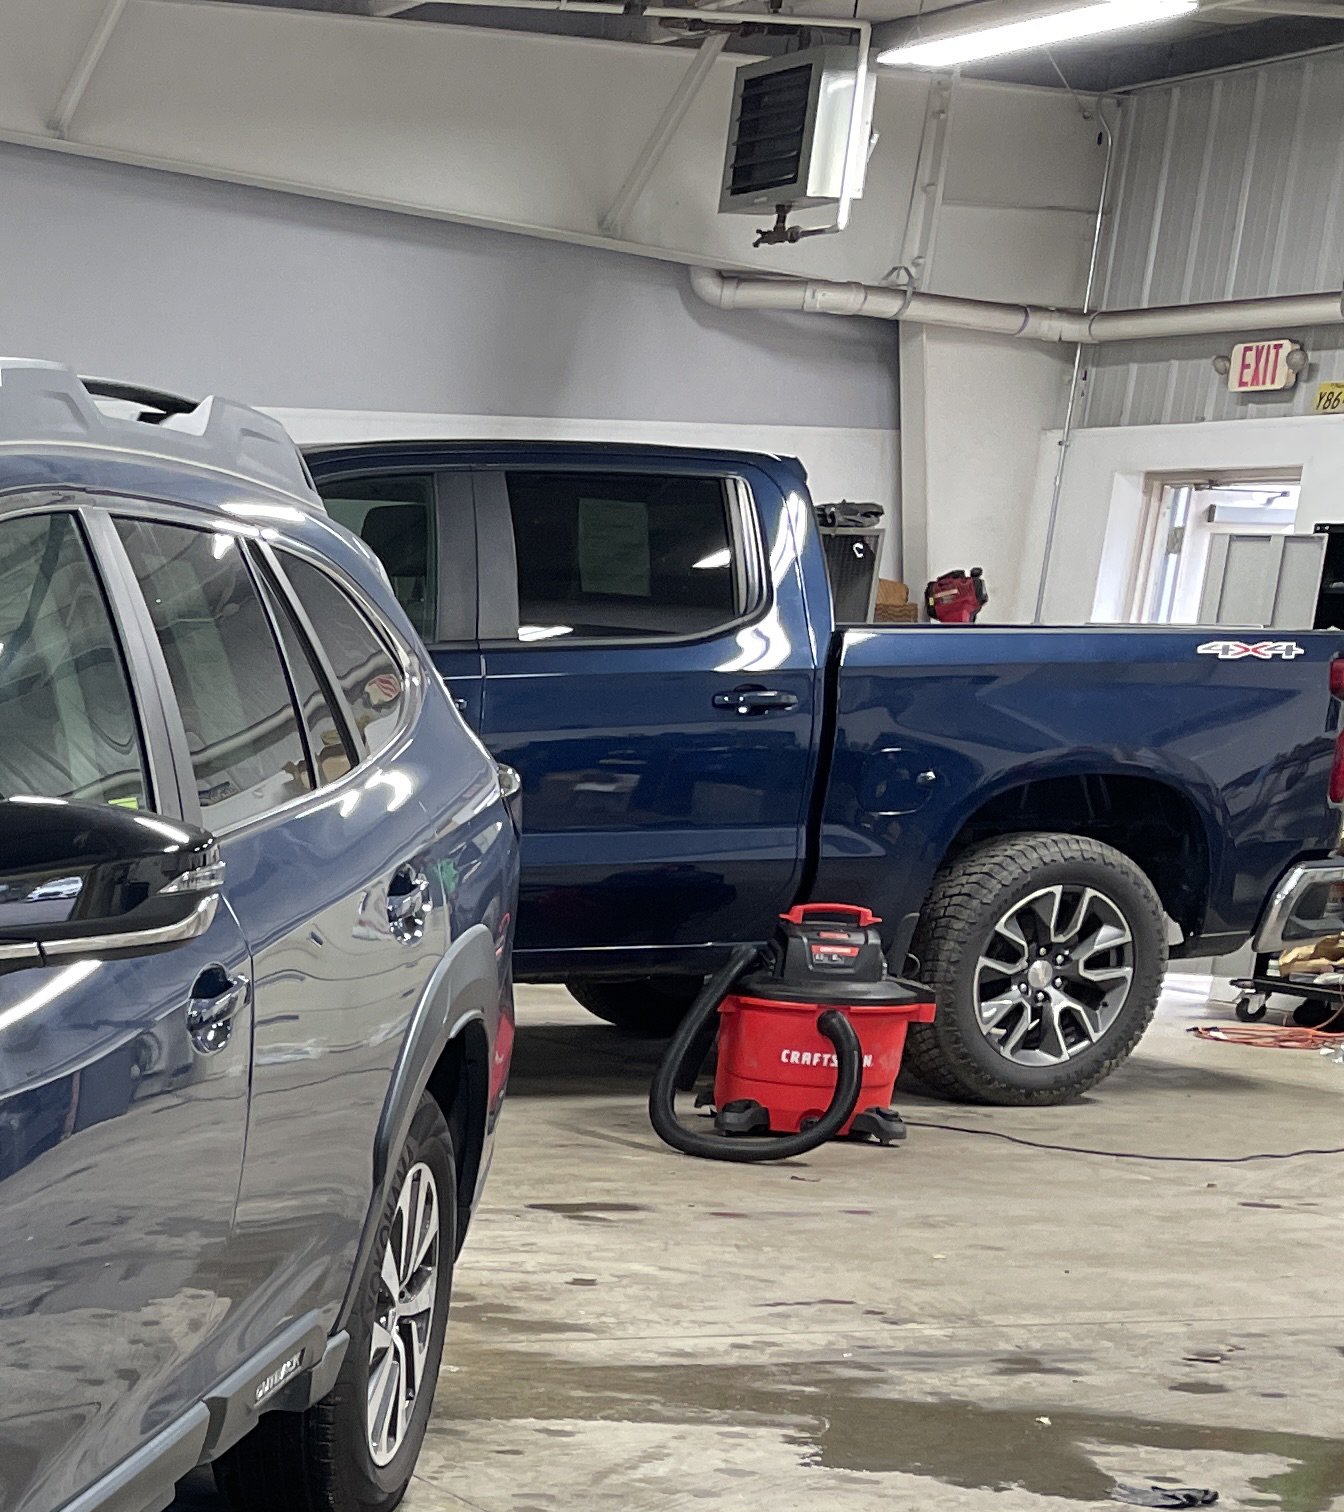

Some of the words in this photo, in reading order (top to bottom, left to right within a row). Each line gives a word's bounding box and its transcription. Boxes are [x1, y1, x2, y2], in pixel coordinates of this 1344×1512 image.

[1238, 343, 1284, 388] EXIT
[1316, 391, 1344, 410] Y86
[781, 1049, 874, 1068] CRAFTSN
